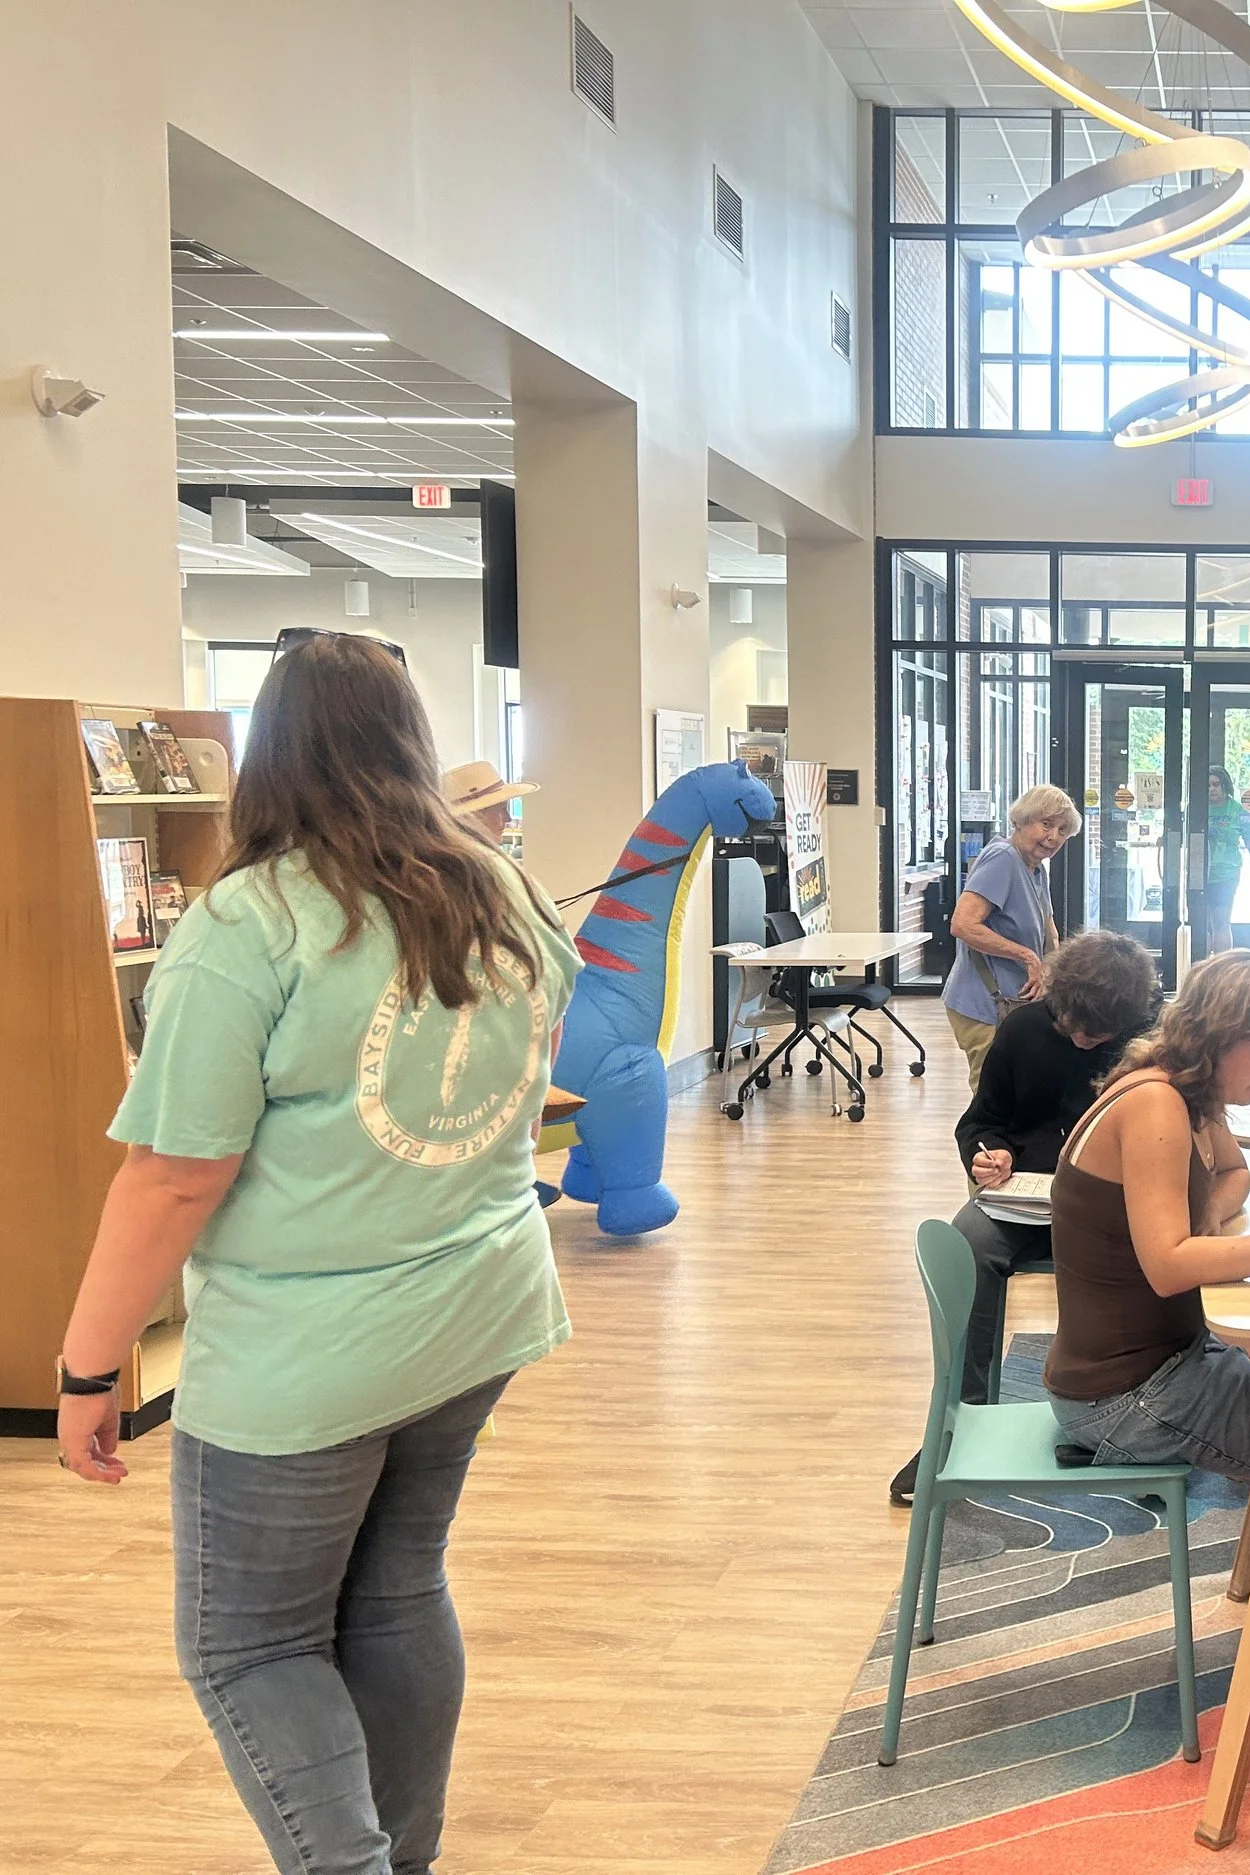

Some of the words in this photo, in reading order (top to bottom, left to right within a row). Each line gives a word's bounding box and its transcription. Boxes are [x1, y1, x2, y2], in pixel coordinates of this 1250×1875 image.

[418, 486, 444, 506] EXIT
[1177, 478, 1209, 504] EXIT
[795, 812, 811, 832] GET
[797, 832, 822, 854] READY
[800, 863, 821, 905] read
[428, 1092, 500, 1131] VIRGINIA
